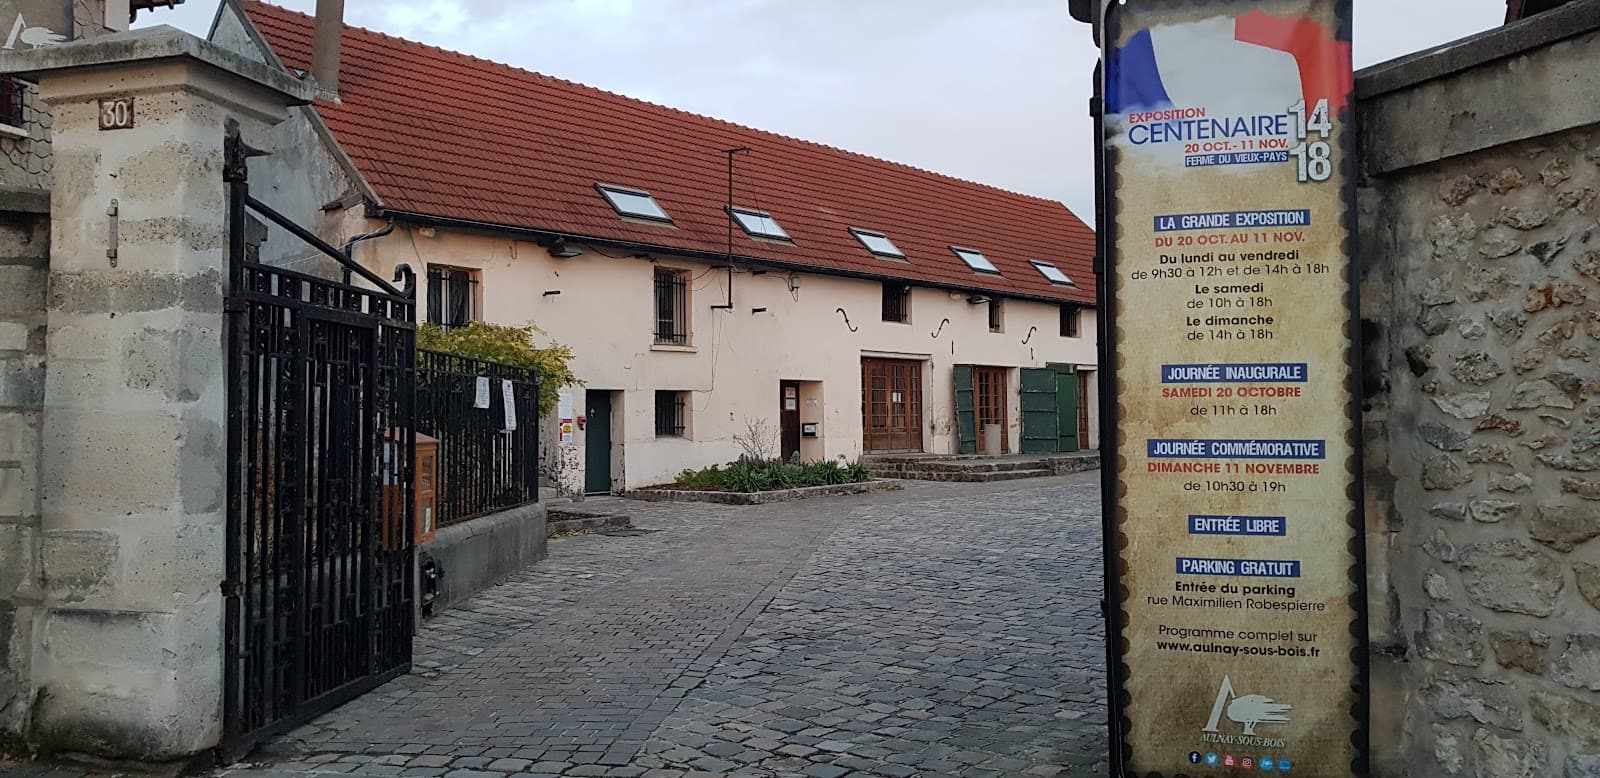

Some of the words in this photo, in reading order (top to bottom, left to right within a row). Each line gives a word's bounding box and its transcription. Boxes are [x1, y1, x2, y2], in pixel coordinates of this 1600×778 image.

[103, 101, 127, 127] 30
[1129, 107, 1206, 124] EXPOSITION
[1288, 98, 1332, 139] 14
[1128, 115, 1288, 145] CENTENAIRE
[1185, 144, 1199, 153] 20
[1242, 141, 1254, 150] 11
[1259, 139, 1288, 149] NOV.
[1186, 156, 1214, 166] FERME
[1219, 154, 1231, 163] DU
[1235, 151, 1287, 163] VIEUX-PAYS
[1289, 141, 1332, 182] 18
[1160, 218, 1175, 230] LA
[1182, 214, 1230, 228] GRANDE
[1236, 212, 1304, 226] EXPOSITION
[1155, 237, 1173, 247] DU
[1177, 236, 1192, 246] 20
[1199, 234, 1228, 245] OCT.
[1230, 234, 1248, 244] AU
[1254, 233, 1267, 243] 11
[1273, 232, 1305, 242] NOV.
[1160, 255, 1177, 264] Du
[1181, 253, 1214, 263] lundi
[1219, 252, 1235, 261] au
[1240, 250, 1299, 261] vendredi
[1132, 270, 1148, 280] de
[1151, 268, 1182, 279] 9h30
[1187, 266, 1195, 278] à
[1200, 266, 1222, 277] 12h
[1227, 266, 1239, 276] et
[1243, 265, 1260, 275] de
[1266, 264, 1288, 275] 14h
[1293, 263, 1301, 274] à
[1307, 264, 1329, 274] 18h
[1195, 284, 1209, 294] Le
[1214, 283, 1264, 293] samedi
[1187, 300, 1203, 308] de
[1209, 298, 1231, 308] 10h
[1236, 297, 1244, 307] à
[1250, 297, 1272, 307] 18h
[1187, 317, 1200, 326] Le
[1205, 315, 1273, 326] dimanche
[1187, 331, 1204, 340] de
[1209, 330, 1231, 340] 14h
[1236, 329, 1245, 339] à
[1250, 330, 1273, 339] 18h
[1168, 365, 1220, 380] JOURNÉE
[1226, 367, 1301, 379] INAUGURALE
[1162, 388, 1212, 398] SAMEDI
[1217, 388, 1232, 397] 20
[1237, 387, 1300, 397] OCTOBRE
[1190, 406, 1208, 416] de
[1212, 406, 1235, 415] 11h
[1240, 404, 1249, 415] à
[1254, 406, 1276, 415] 18h
[1154, 440, 1205, 455] JOURNÉE
[1212, 440, 1319, 456] COMMÉMORATIVE
[1148, 463, 1220, 473] DIMANCHE
[1226, 464, 1239, 473] 11
[1245, 464, 1319, 474] NOVEMBRE
[1184, 481, 1201, 491] de
[1206, 481, 1245, 492] 10h30
[1249, 480, 1257, 492] à
[1263, 482, 1286, 493] 19h
[1195, 516, 1240, 532] ENTRÉE
[1246, 520, 1279, 533] LIBRE
[1182, 560, 1234, 574] PARKING
[1241, 561, 1293, 575] GRATUIT
[1175, 581, 1216, 593] Entrée
[1221, 583, 1238, 593] du
[1243, 585, 1295, 597] parking
[1147, 597, 1168, 605] rue
[1172, 596, 1242, 608] Maximilien
[1247, 599, 1325, 612] Robespierre
[1159, 625, 1234, 639] Programme
[1238, 631, 1293, 641] complet
[1297, 632, 1317, 642] sur
[1157, 641, 1320, 657] www.aulnay-sous-bois.fr
[1200, 733, 1286, 748] AULNAY-SOUS-BOIS
